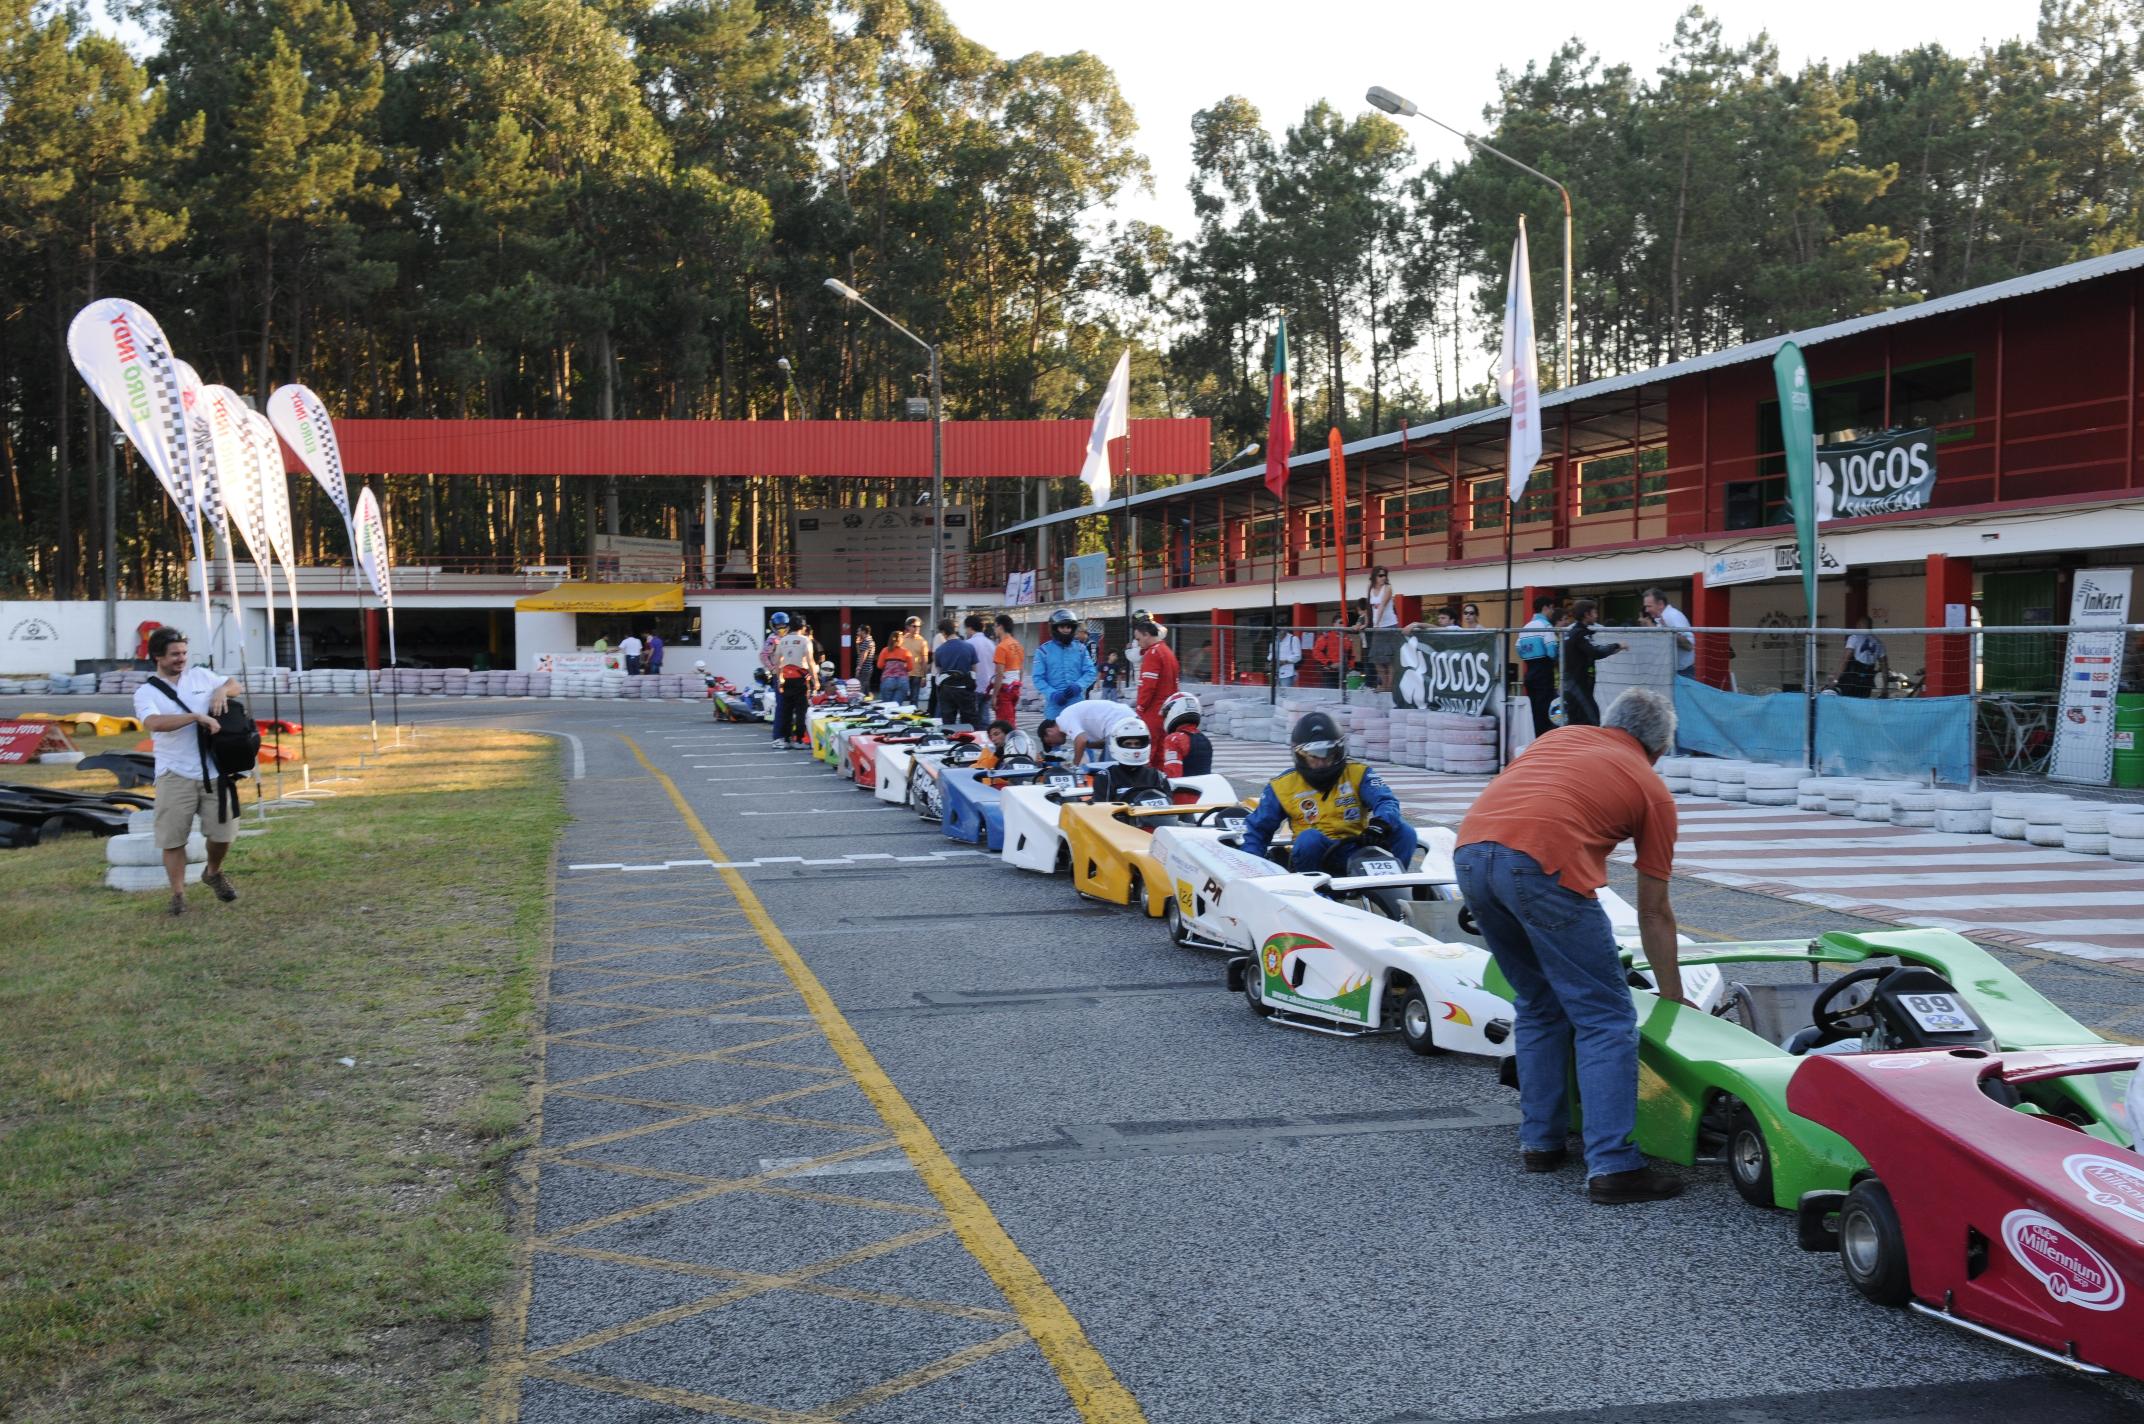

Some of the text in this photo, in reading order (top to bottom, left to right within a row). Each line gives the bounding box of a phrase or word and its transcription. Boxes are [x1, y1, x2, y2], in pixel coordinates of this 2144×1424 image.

[1837, 442, 1930, 512] JOGOS
[2083, 592, 2124, 610] InKart
[1428, 651, 1490, 703] JOGOS
[1368, 862, 1394, 871] 126
[1907, 995, 1956, 1014] 89
[2032, 1225, 2059, 1244] Clube
[2020, 1226, 2102, 1286] Millennium
[2050, 1275, 2068, 1297] M
